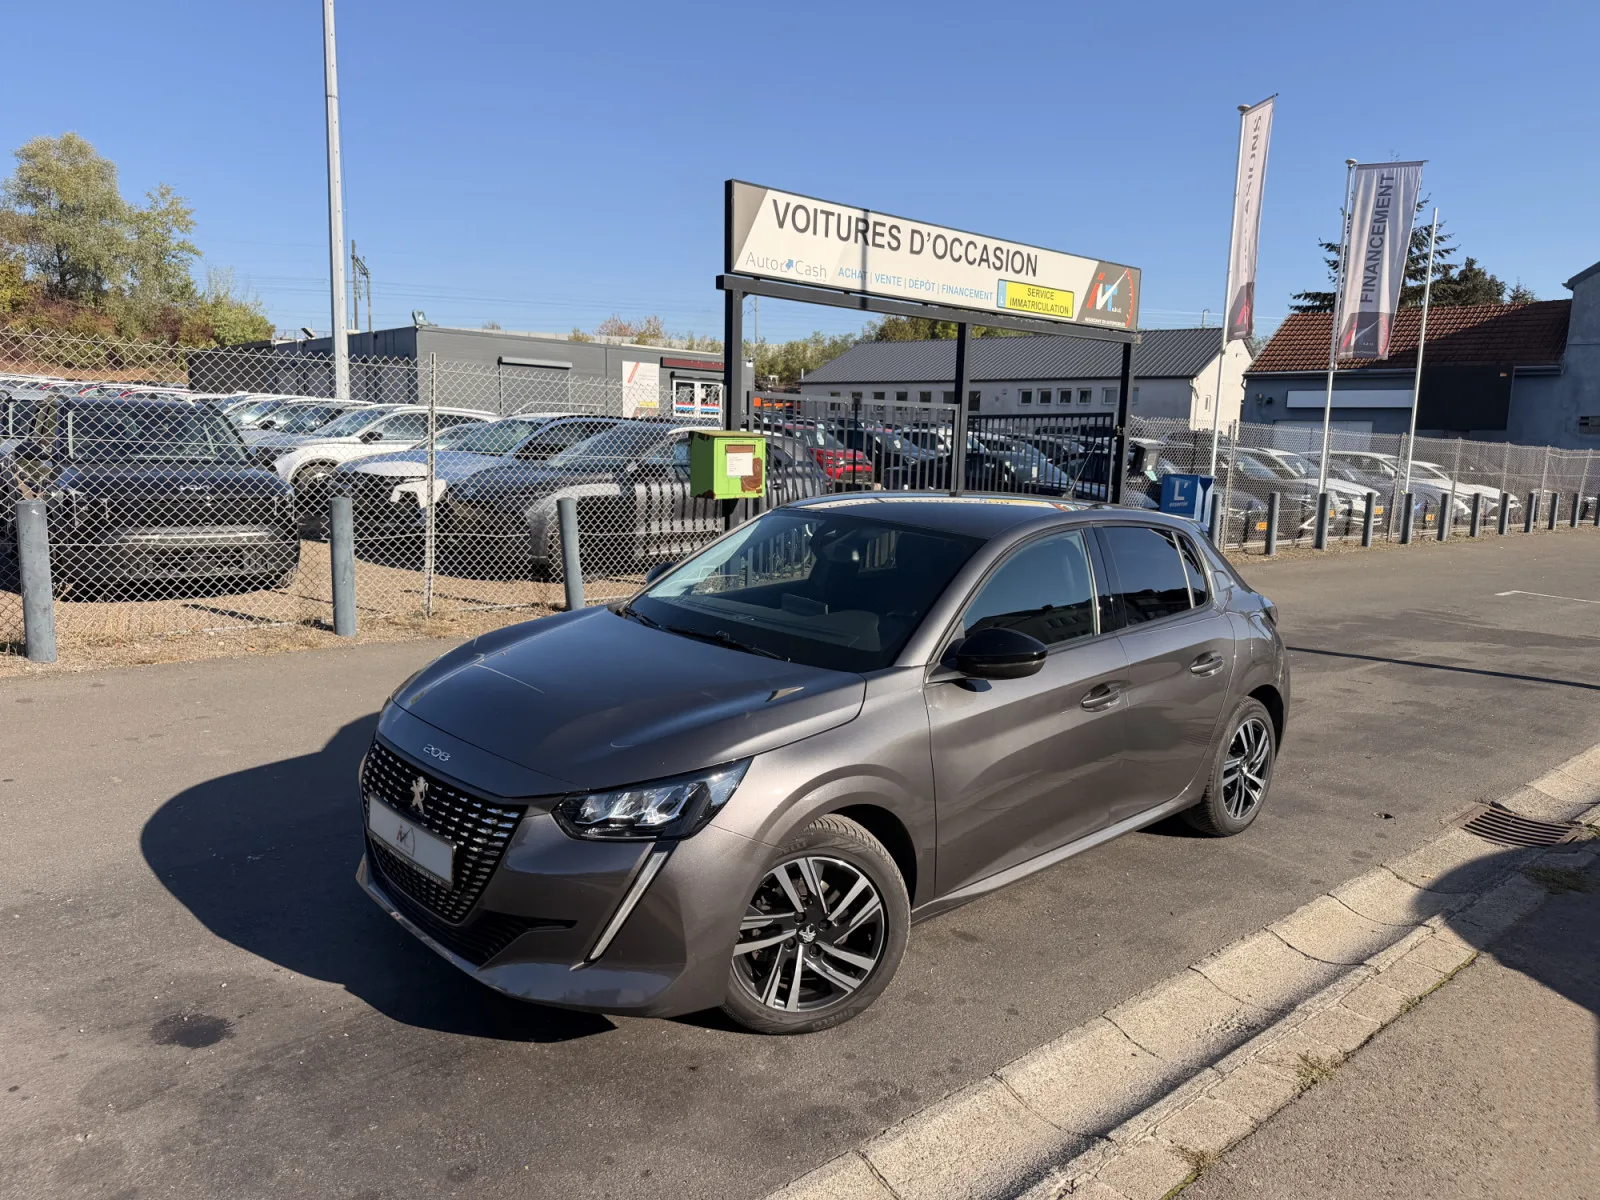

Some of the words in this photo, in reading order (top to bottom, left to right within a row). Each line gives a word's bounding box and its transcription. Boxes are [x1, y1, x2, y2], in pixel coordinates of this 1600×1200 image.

[772, 199, 902, 252] VOITURES
[909, 228, 1038, 278] D'OCCASION
[1360, 173, 1395, 304] FINANCEMENT
[745, 251, 779, 272] Auto
[795, 260, 827, 278] Cash
[838, 267, 868, 281] ACHAT
[874, 272, 903, 287] VENTE
[941, 284, 994, 301] FINANCEMENT
[1027, 287, 1055, 301] SERVICE
[1009, 297, 1069, 315] IMMATRICULATION
[423, 743, 451, 762] 208
